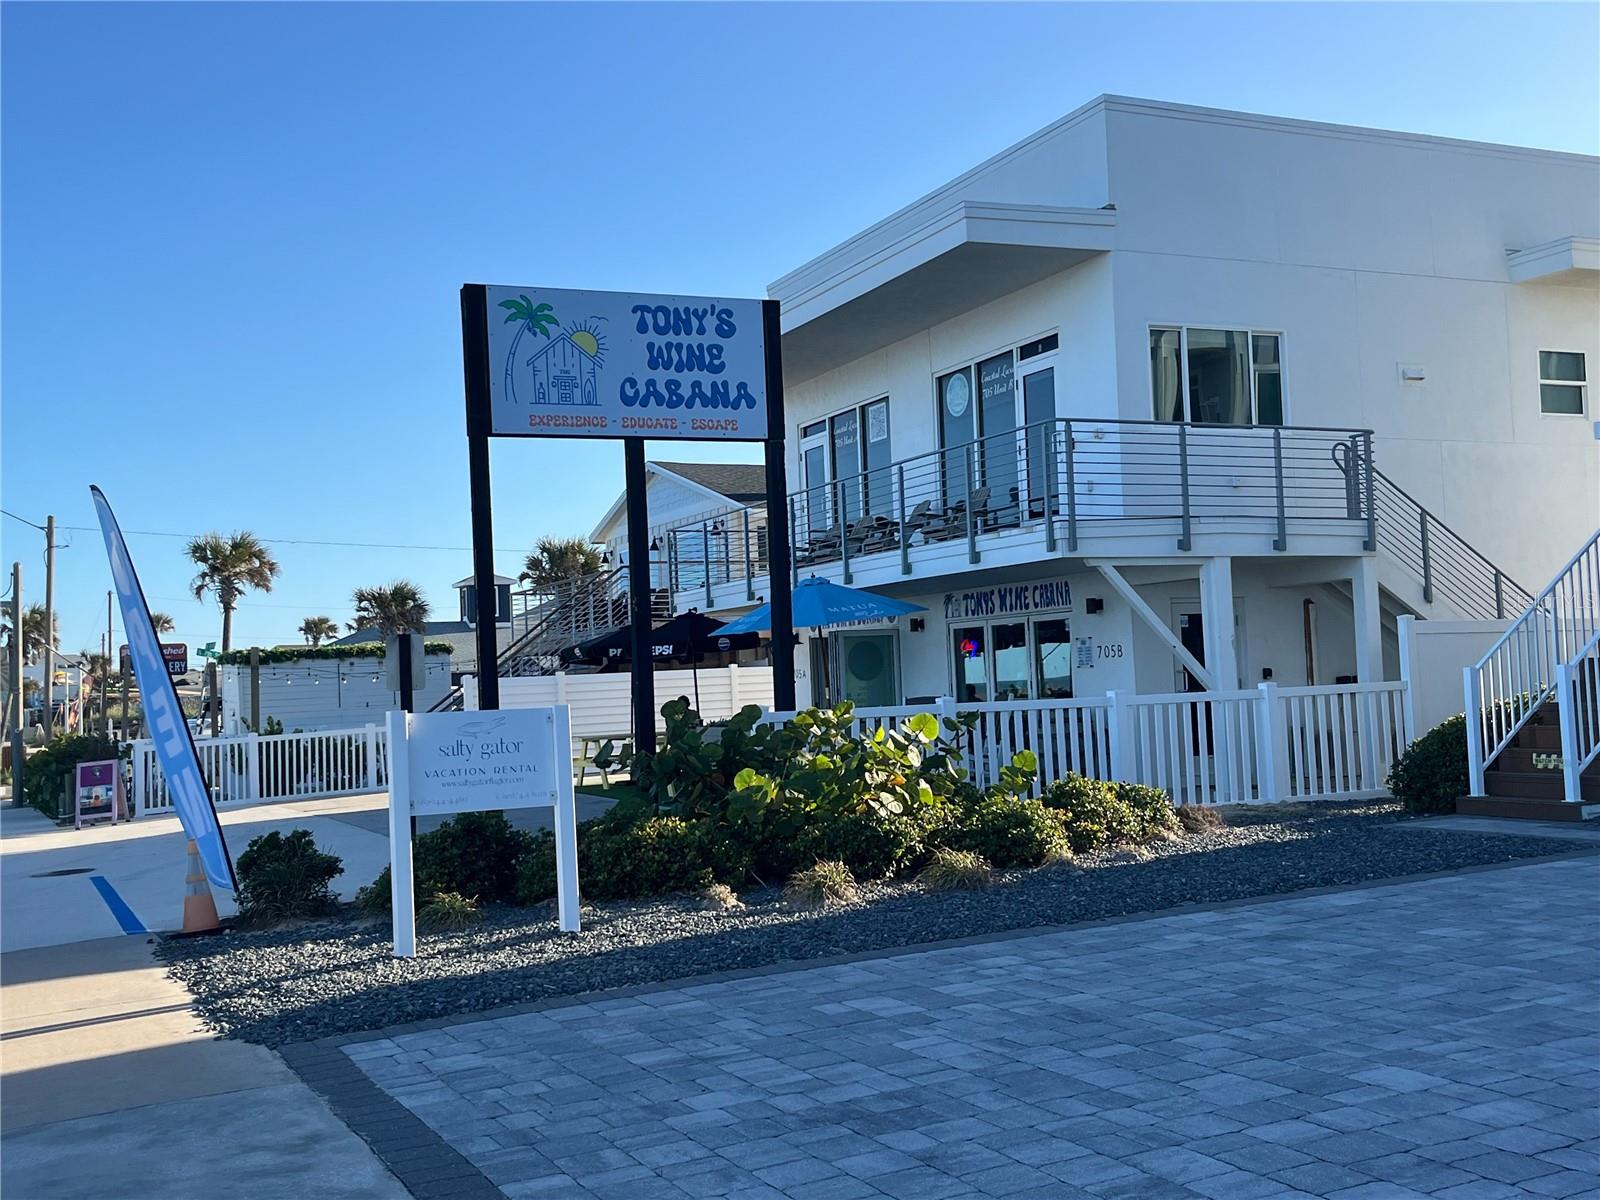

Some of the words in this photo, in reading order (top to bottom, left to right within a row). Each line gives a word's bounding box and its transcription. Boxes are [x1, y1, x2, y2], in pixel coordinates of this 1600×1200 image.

[632, 304, 737, 339] TONY'S
[646, 341, 726, 374] WINE
[620, 377, 757, 410] CABANA
[528, 414, 608, 428] EXPERIENCE
[621, 416, 678, 430] EDUCATE
[691, 418, 739, 431] ESCAPE
[998, 584, 1029, 612] WINE
[1032, 580, 1072, 609] CABANA
[1097, 644, 1124, 659] 705B
[439, 739, 474, 762] salty
[481, 737, 524, 761] gator
[424, 767, 486, 779] VACATION
[493, 764, 538, 776] RENTAL
